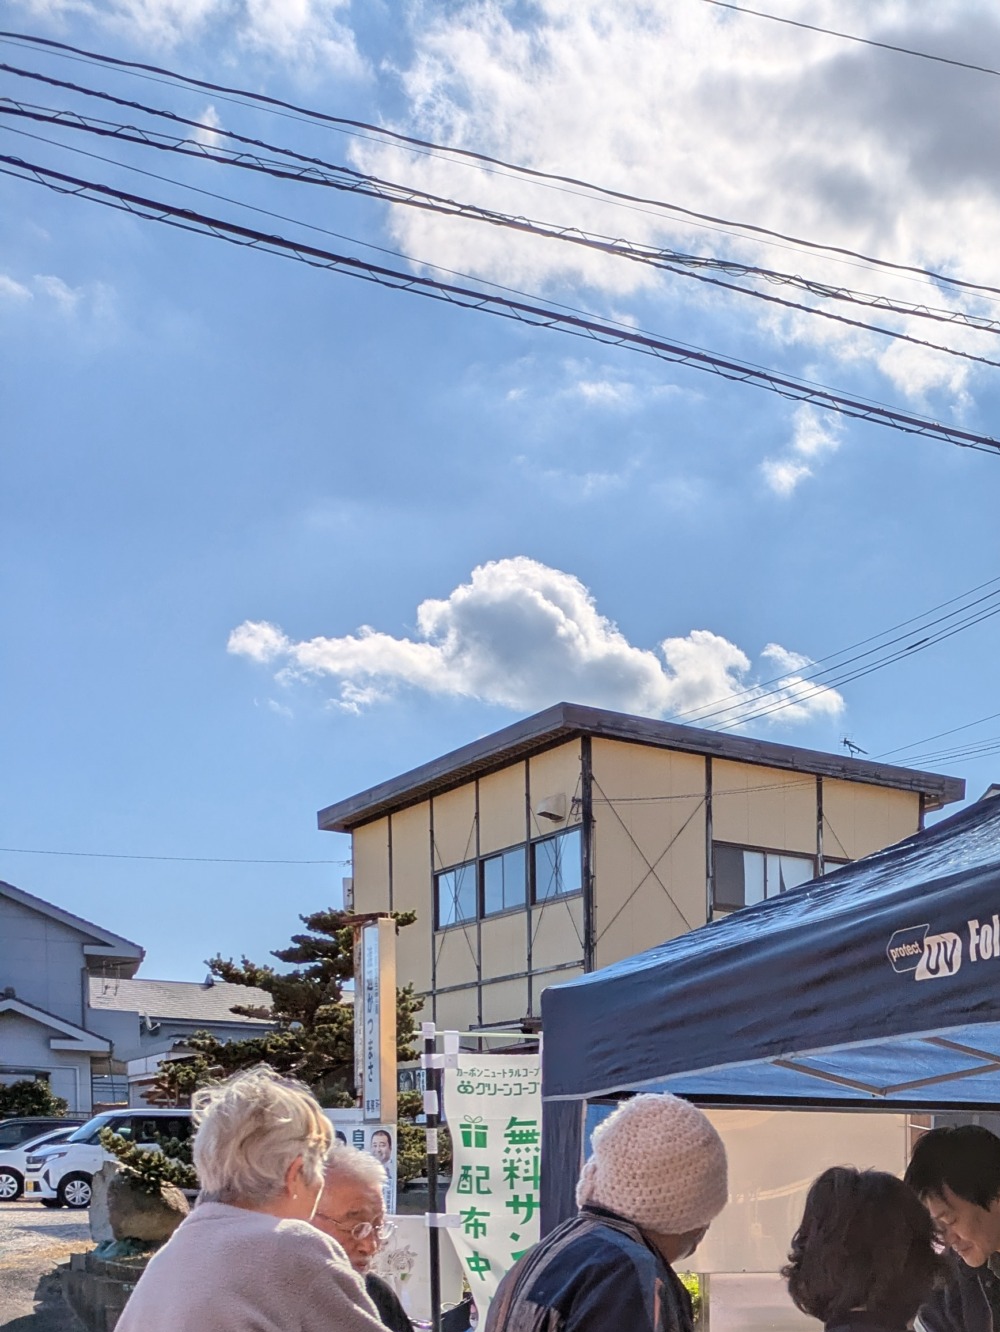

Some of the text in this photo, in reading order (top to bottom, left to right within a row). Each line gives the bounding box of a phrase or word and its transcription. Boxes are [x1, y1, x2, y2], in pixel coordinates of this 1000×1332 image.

[889, 941, 922, 962] protect
[920, 933, 961, 979] UV
[475, 1082, 540, 1096] グリーンコープ
[456, 1165, 492, 1281] 配布中
